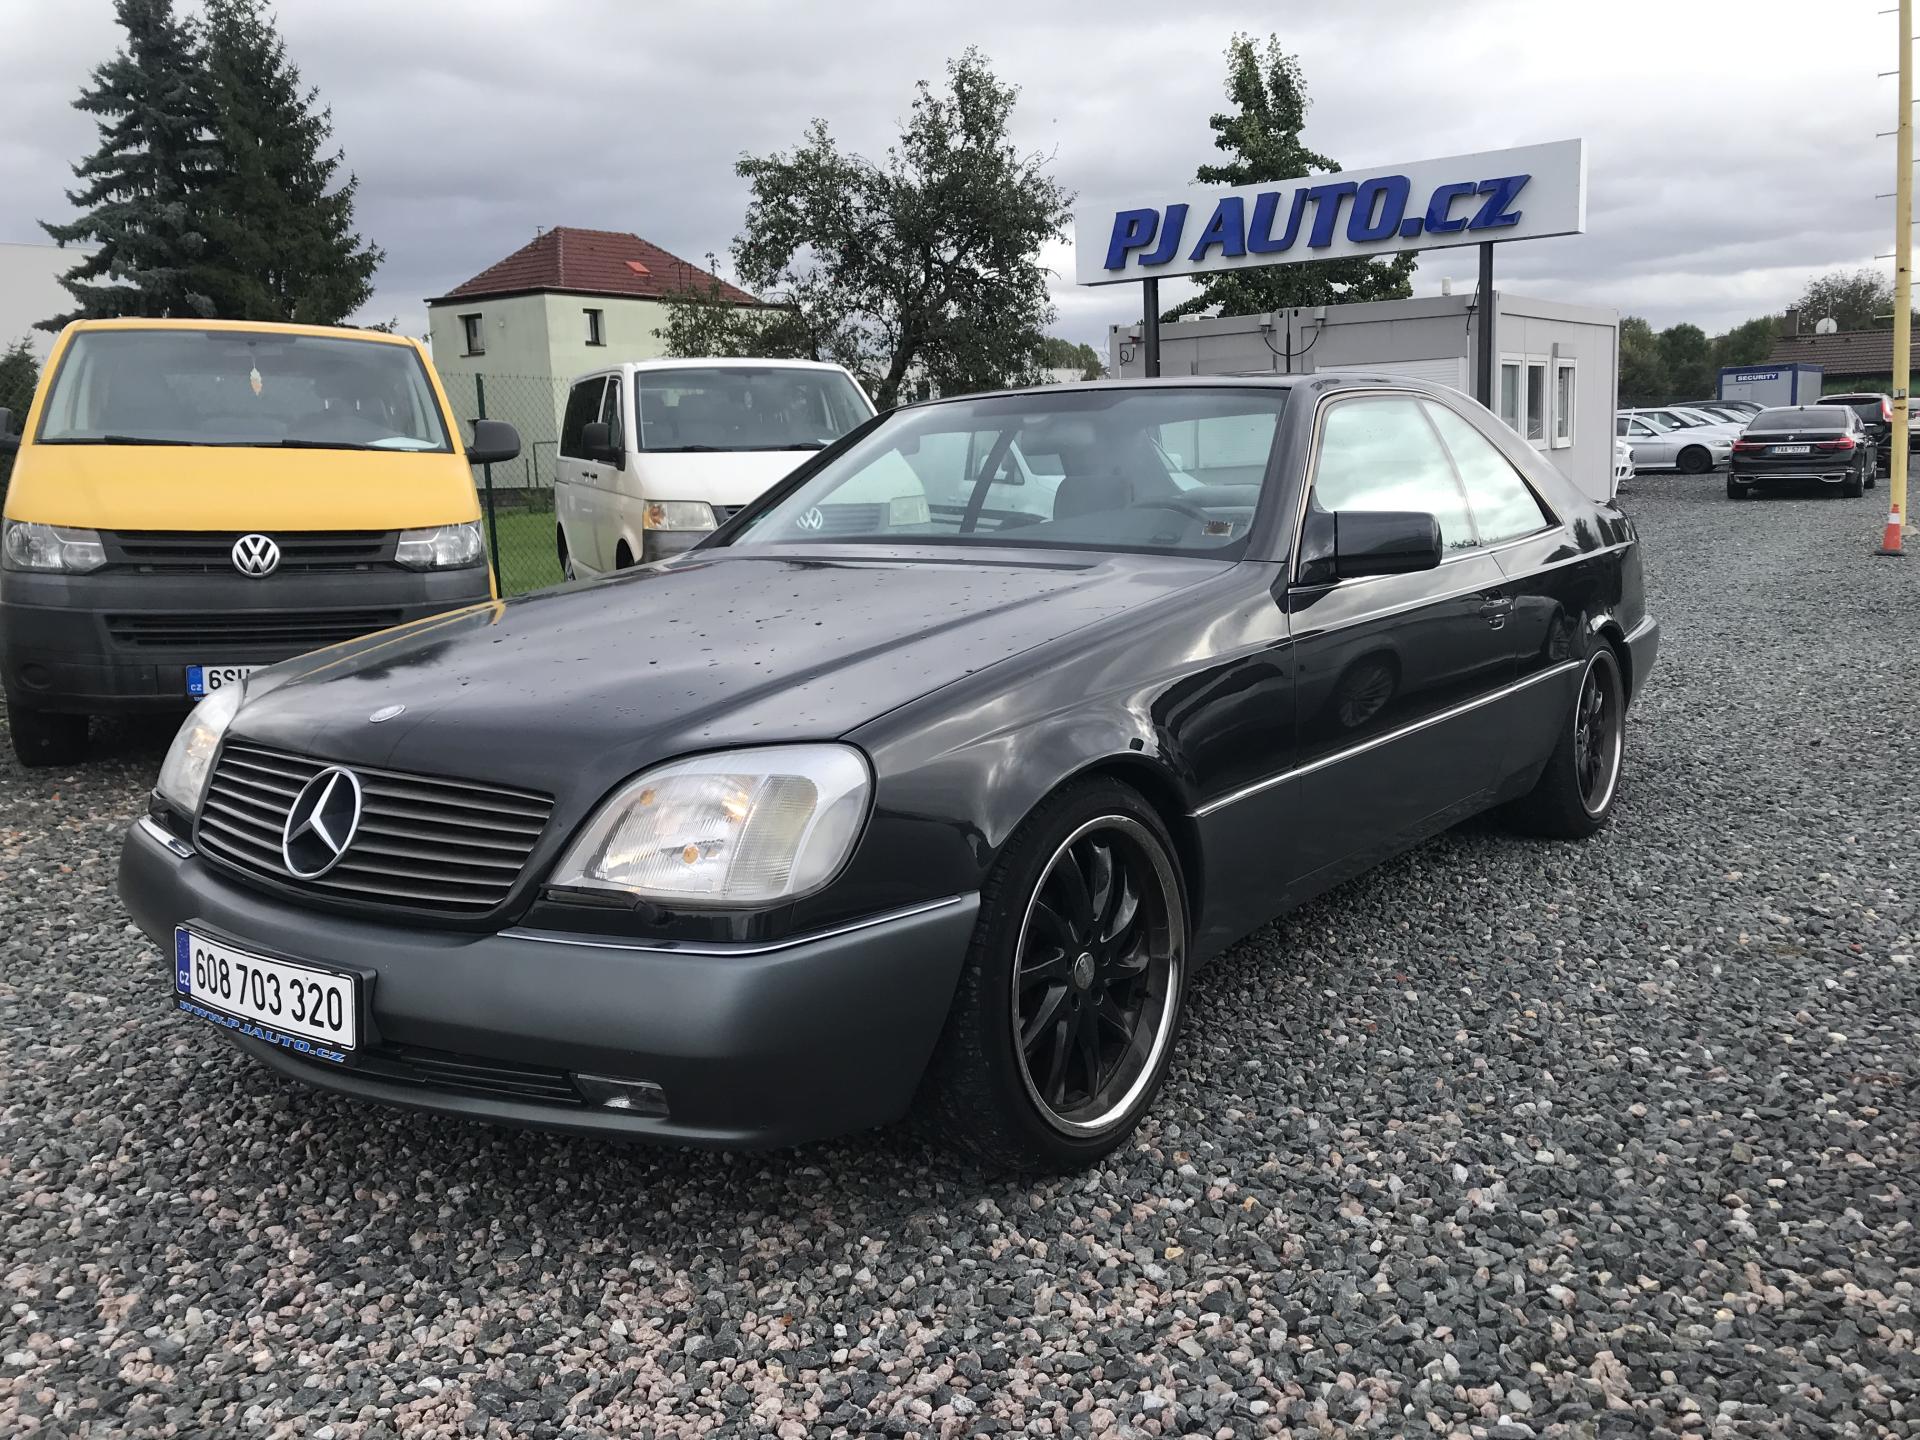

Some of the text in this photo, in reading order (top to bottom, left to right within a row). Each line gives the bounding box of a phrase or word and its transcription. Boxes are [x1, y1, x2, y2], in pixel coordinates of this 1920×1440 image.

[1104, 203, 1189, 270] PJ
[1737, 373, 1777, 381] SECURITY
[190, 683, 202, 691] CZ
[179, 972, 190, 987] CZ
[196, 948, 343, 1032] 608 703 320
